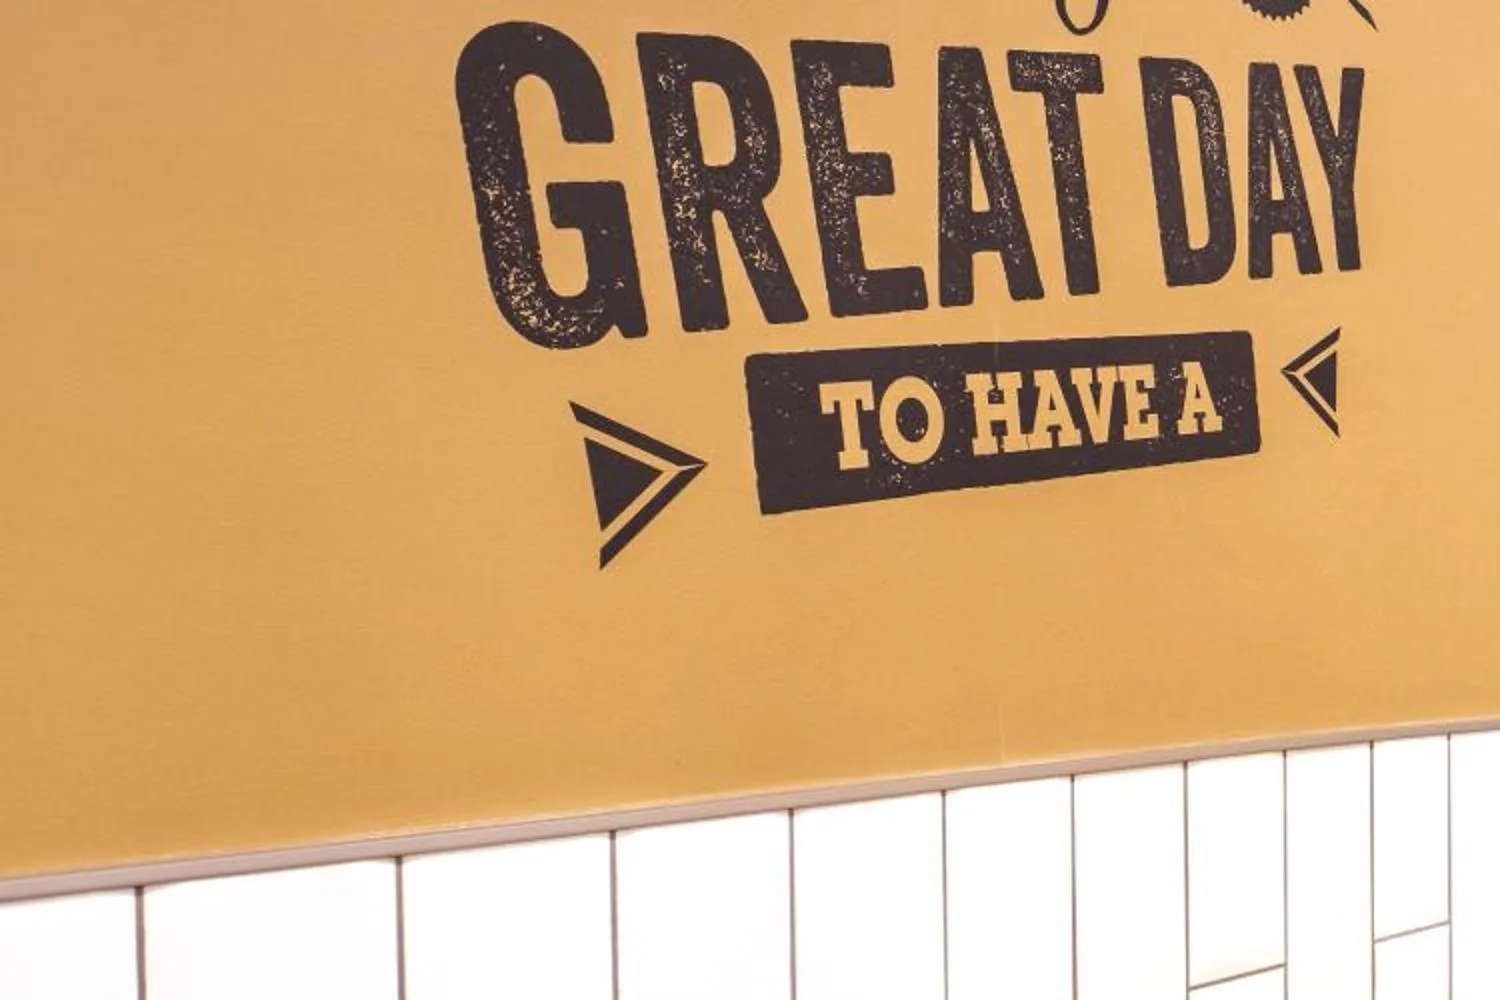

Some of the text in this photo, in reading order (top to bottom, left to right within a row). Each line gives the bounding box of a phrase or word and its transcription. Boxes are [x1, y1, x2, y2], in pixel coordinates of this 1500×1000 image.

[455, 21, 1365, 350] GREAT DAY
[818, 361, 1223, 471] TO HAVE A
